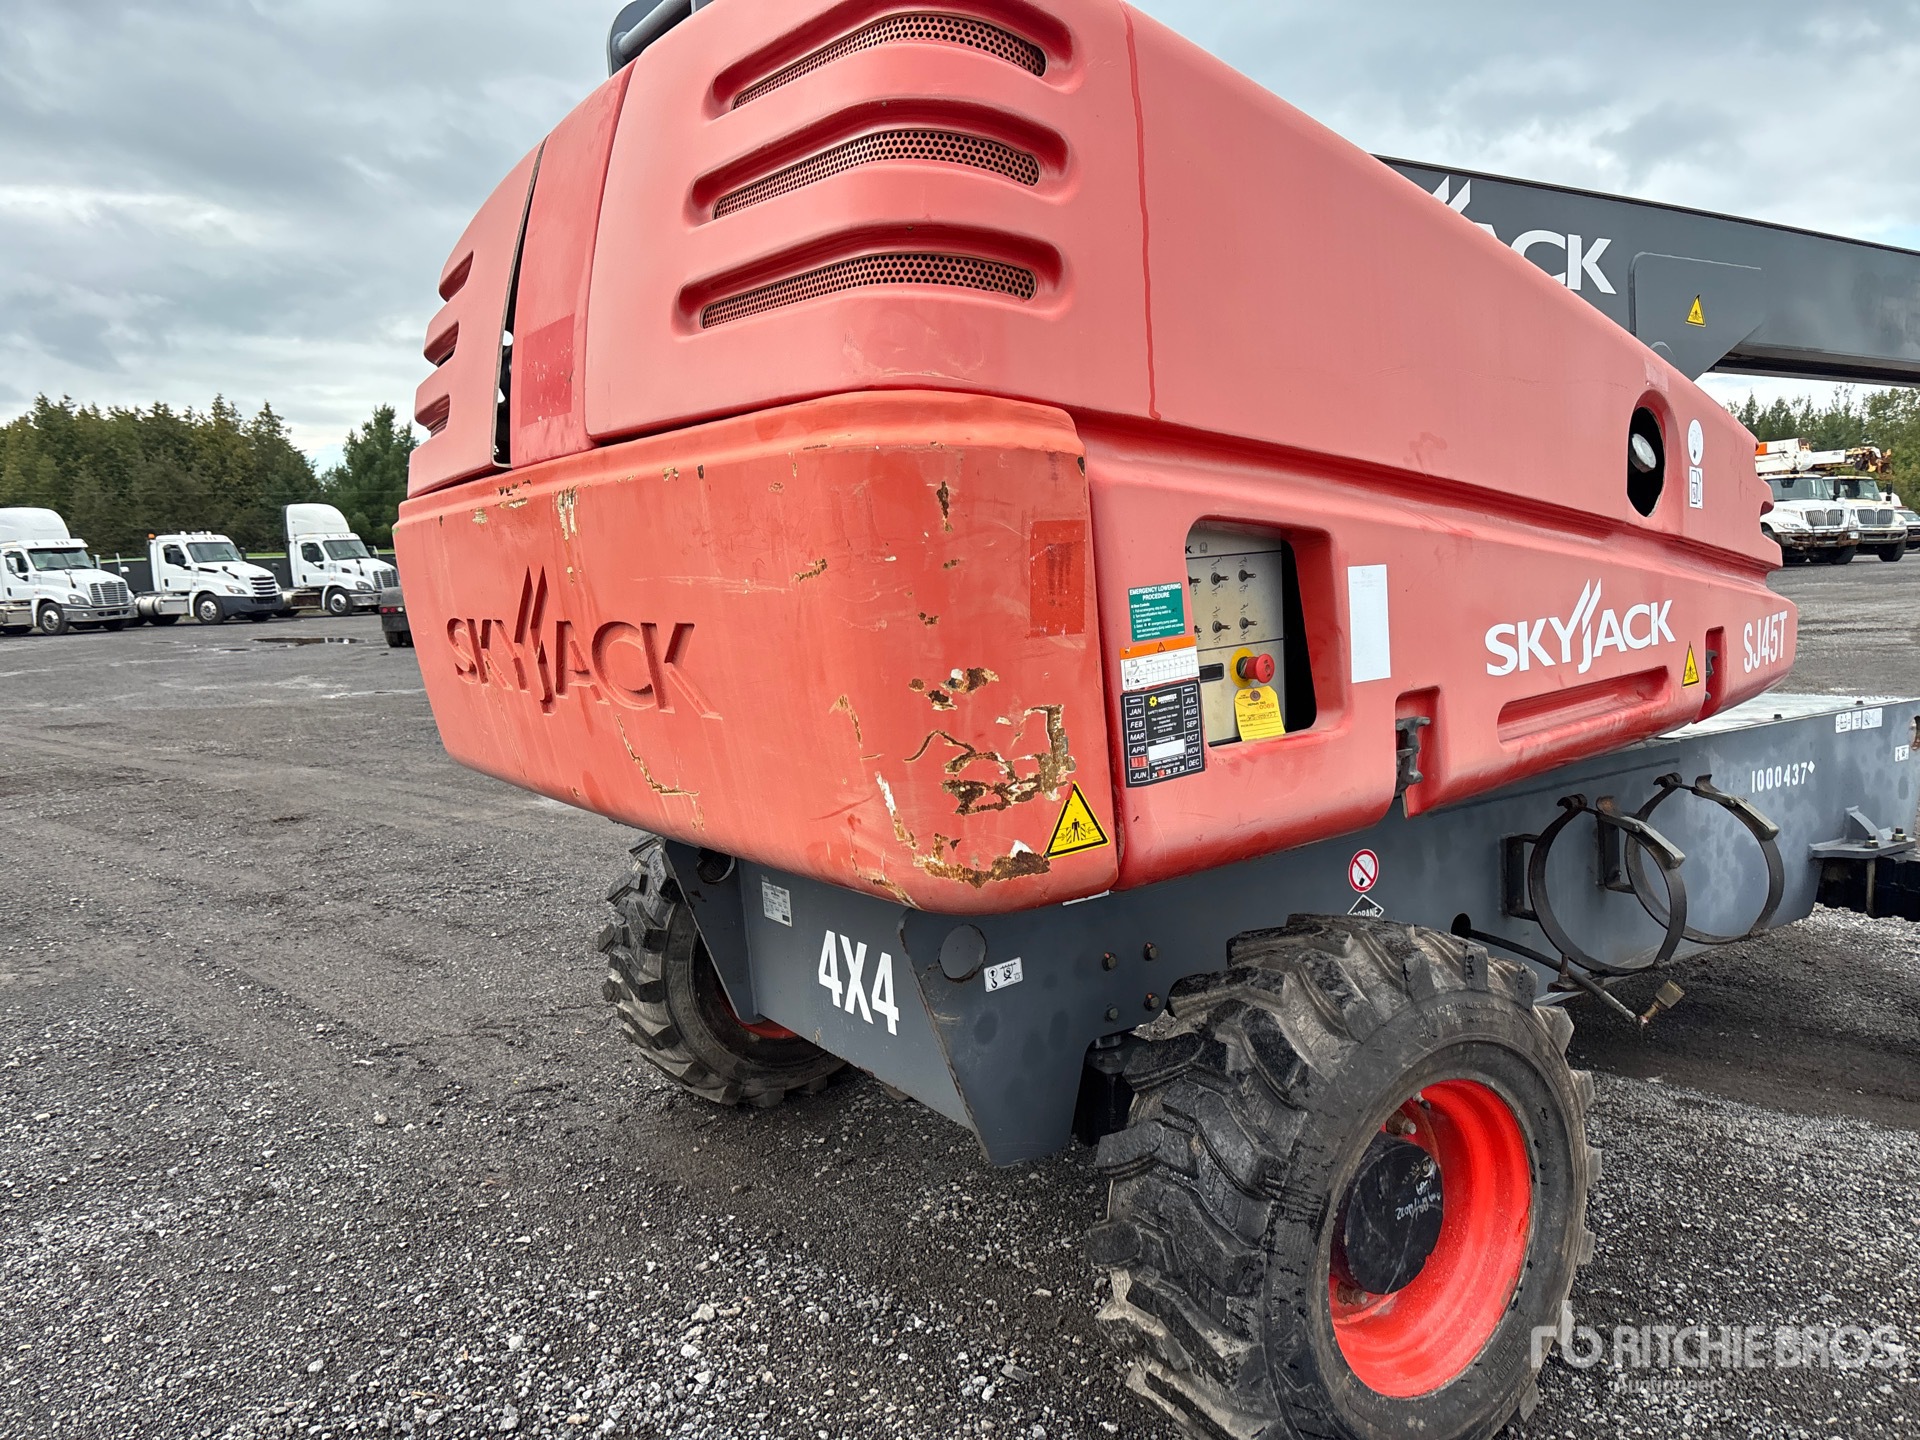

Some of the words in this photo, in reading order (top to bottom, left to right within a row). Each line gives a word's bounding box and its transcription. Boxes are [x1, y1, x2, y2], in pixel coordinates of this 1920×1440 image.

[1129, 586, 1157, 596] EMERGENCY
[1158, 583, 1181, 592] LOWERING
[1142, 592, 1170, 601] PROCEDURE
[1485, 577, 1676, 676] SKYJACK
[447, 565, 723, 720] SKYJACK
[1743, 610, 1787, 673] SJ45T
[1185, 696, 1195, 704] JUL
[1130, 708, 1142, 716] JAN
[1185, 707, 1197, 716] AUG
[1130, 720, 1143, 728] FEB
[1186, 720, 1197, 728] SEP
[1130, 733, 1145, 741] MAR
[1187, 733, 1198, 742] OCT
[1131, 745, 1145, 754] APR
[1187, 746, 1199, 754] NOV
[1188, 758, 1200, 767] DEC
[1133, 771, 1146, 779] JUN
[818, 929, 899, 1036] 4X4
